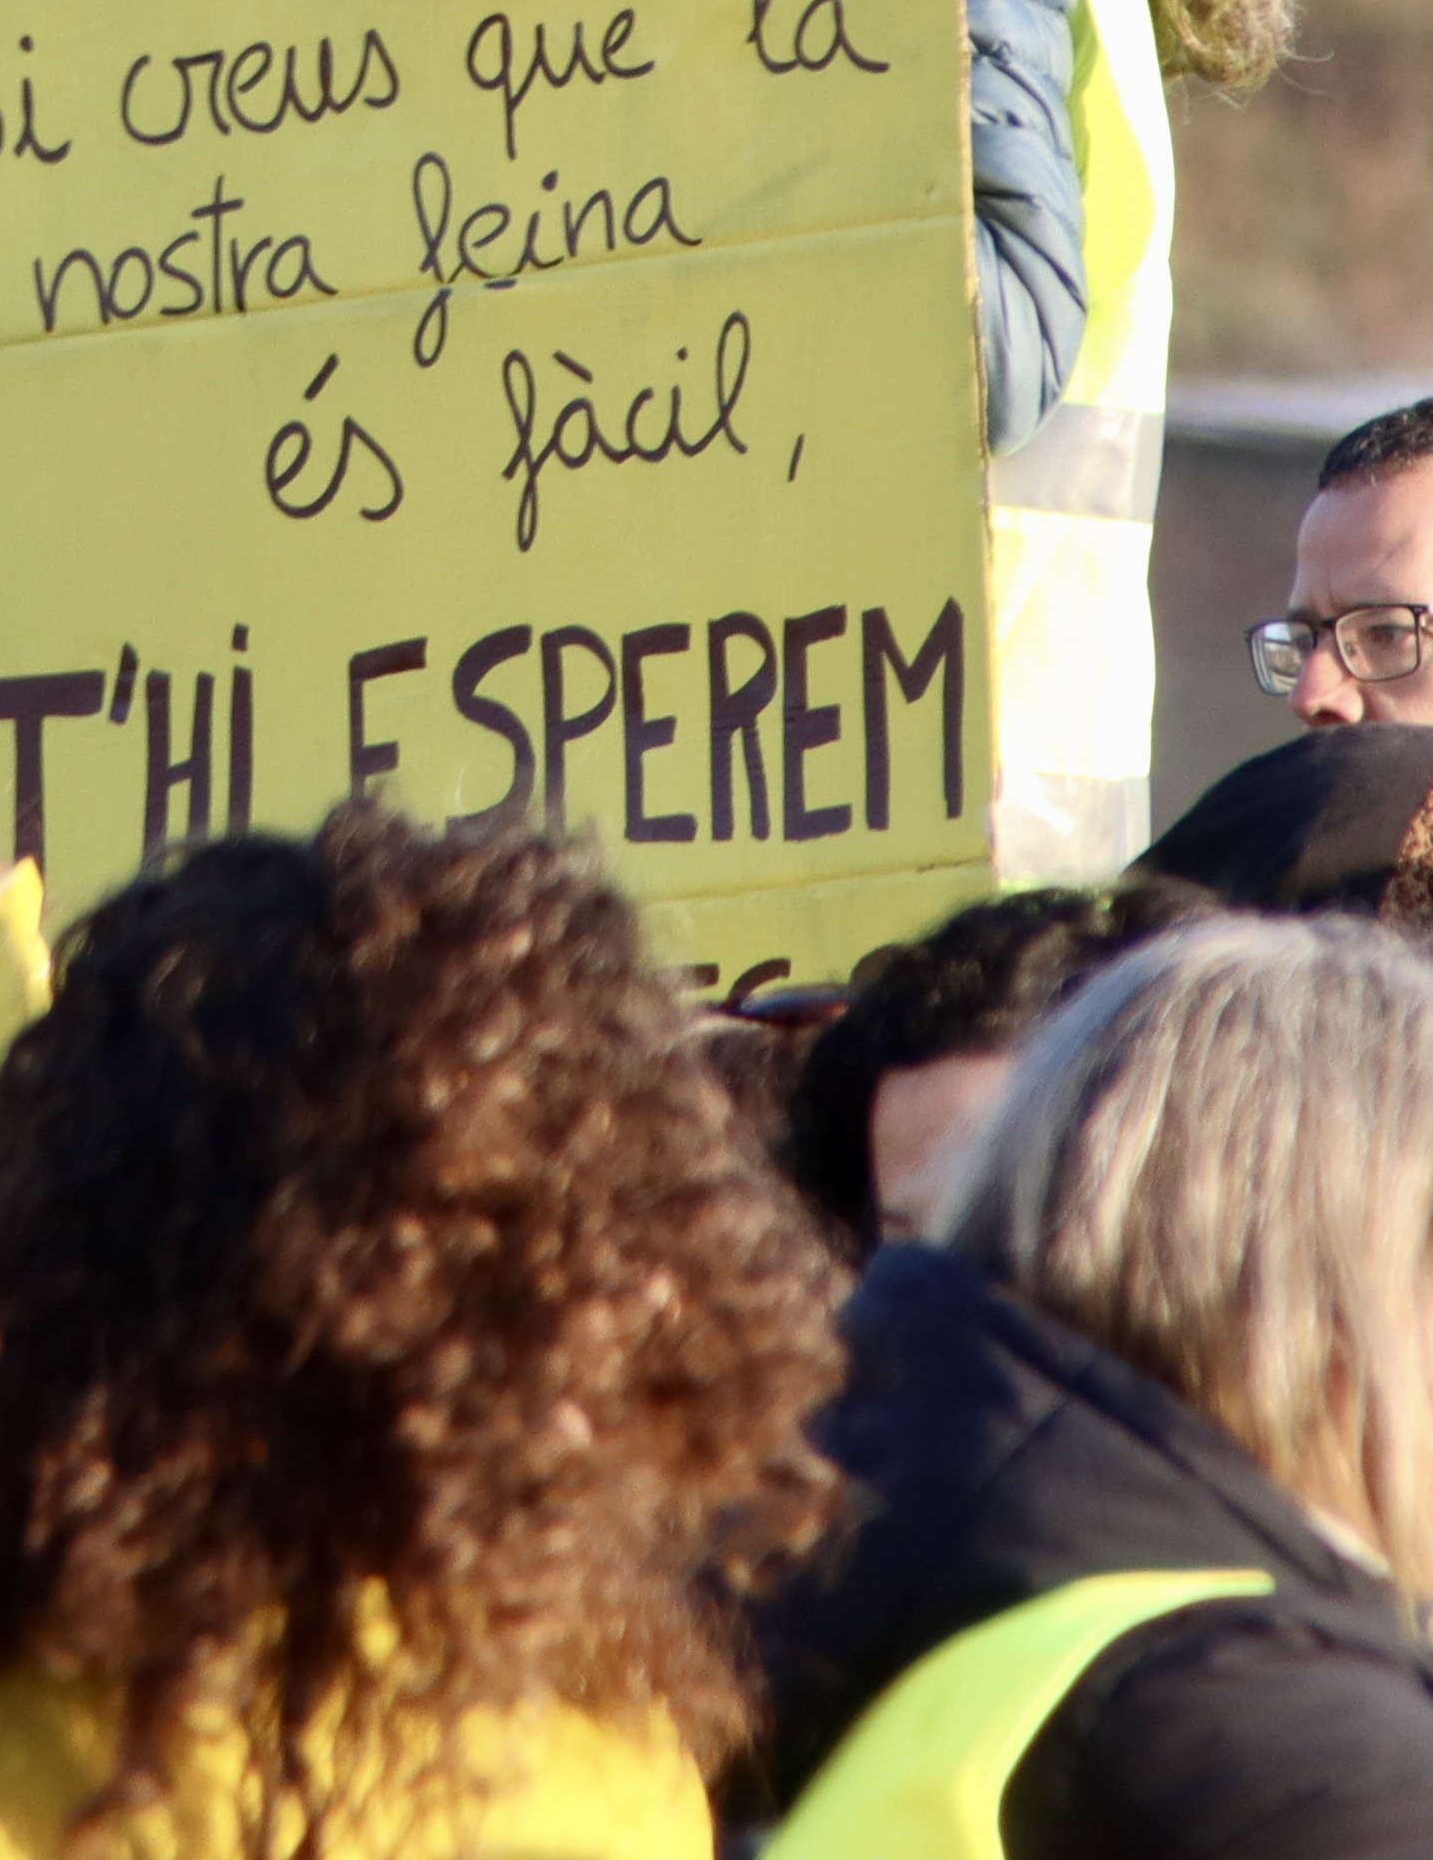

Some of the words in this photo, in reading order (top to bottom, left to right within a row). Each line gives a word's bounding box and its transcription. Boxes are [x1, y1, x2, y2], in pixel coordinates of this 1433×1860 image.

[121, 29, 399, 145] creus
[466, 9, 654, 160] que
[34, 175, 338, 333] nostra
[413, 153, 702, 370] feina
[265, 354, 403, 521] és
[502, 311, 803, 552] fàcil,
[348, 597, 964, 844] ESPEREM
